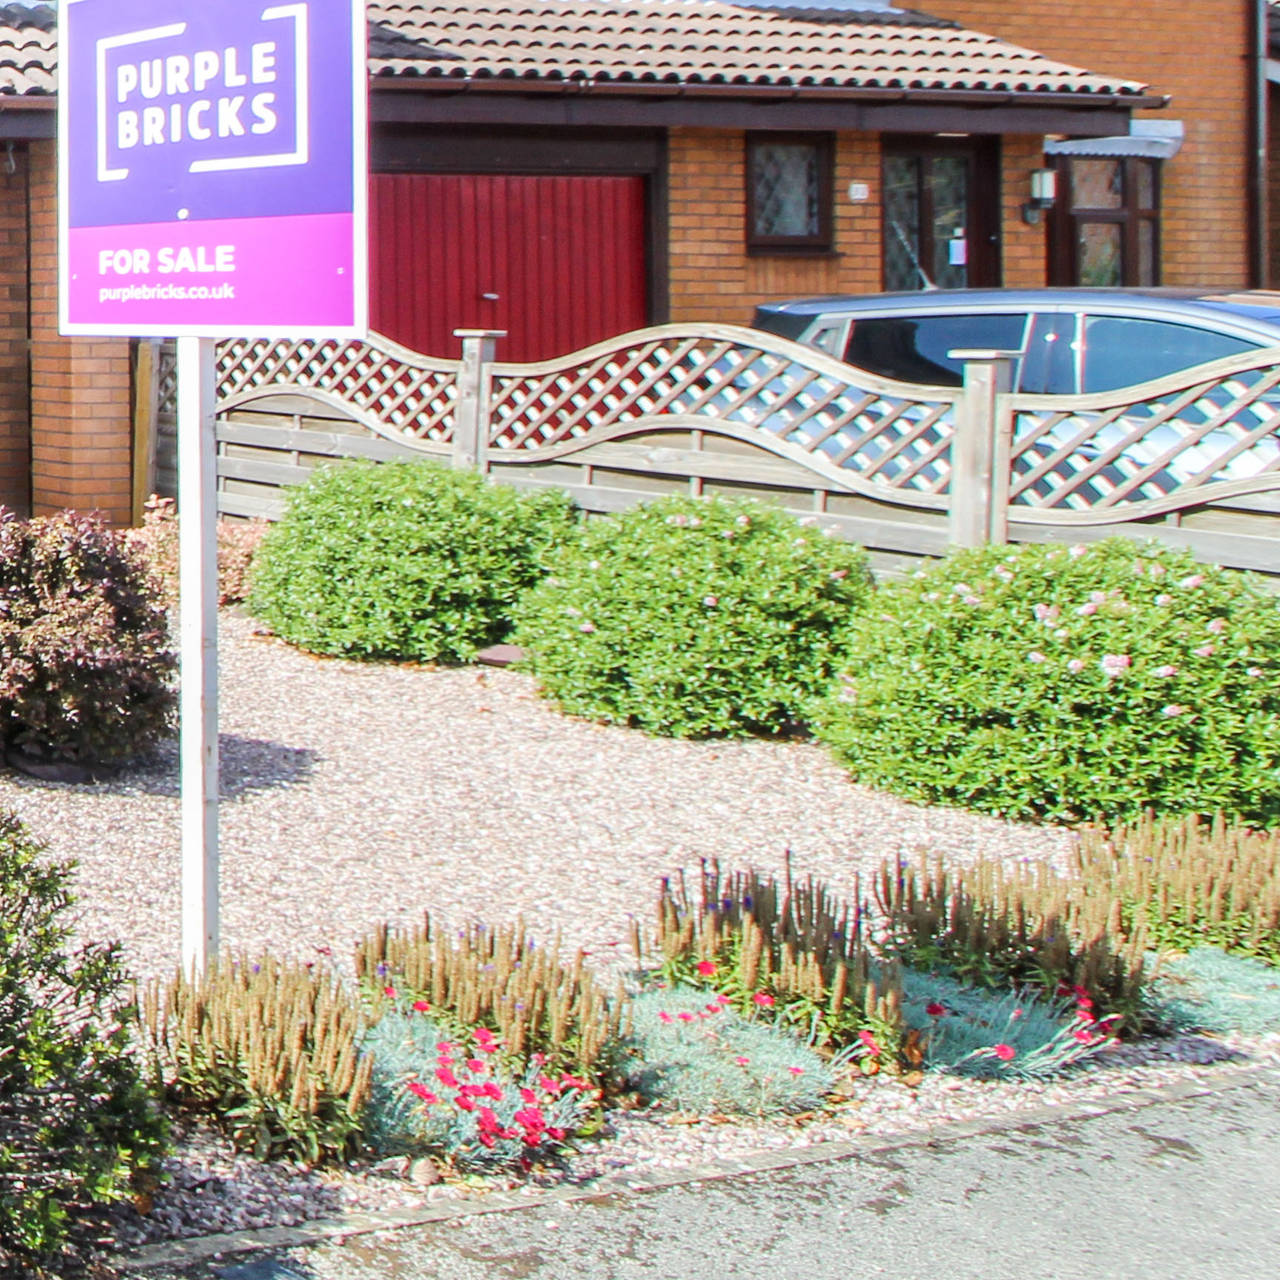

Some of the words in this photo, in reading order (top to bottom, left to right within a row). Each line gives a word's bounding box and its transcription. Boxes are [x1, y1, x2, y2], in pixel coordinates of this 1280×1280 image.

[117, 41, 276, 103] PURPLE
[117, 92, 277, 149] BRICKS
[98, 248, 151, 275] FOR
[157, 245, 236, 274] SALE
[98, 282, 236, 303] purplebricks.co.uk
